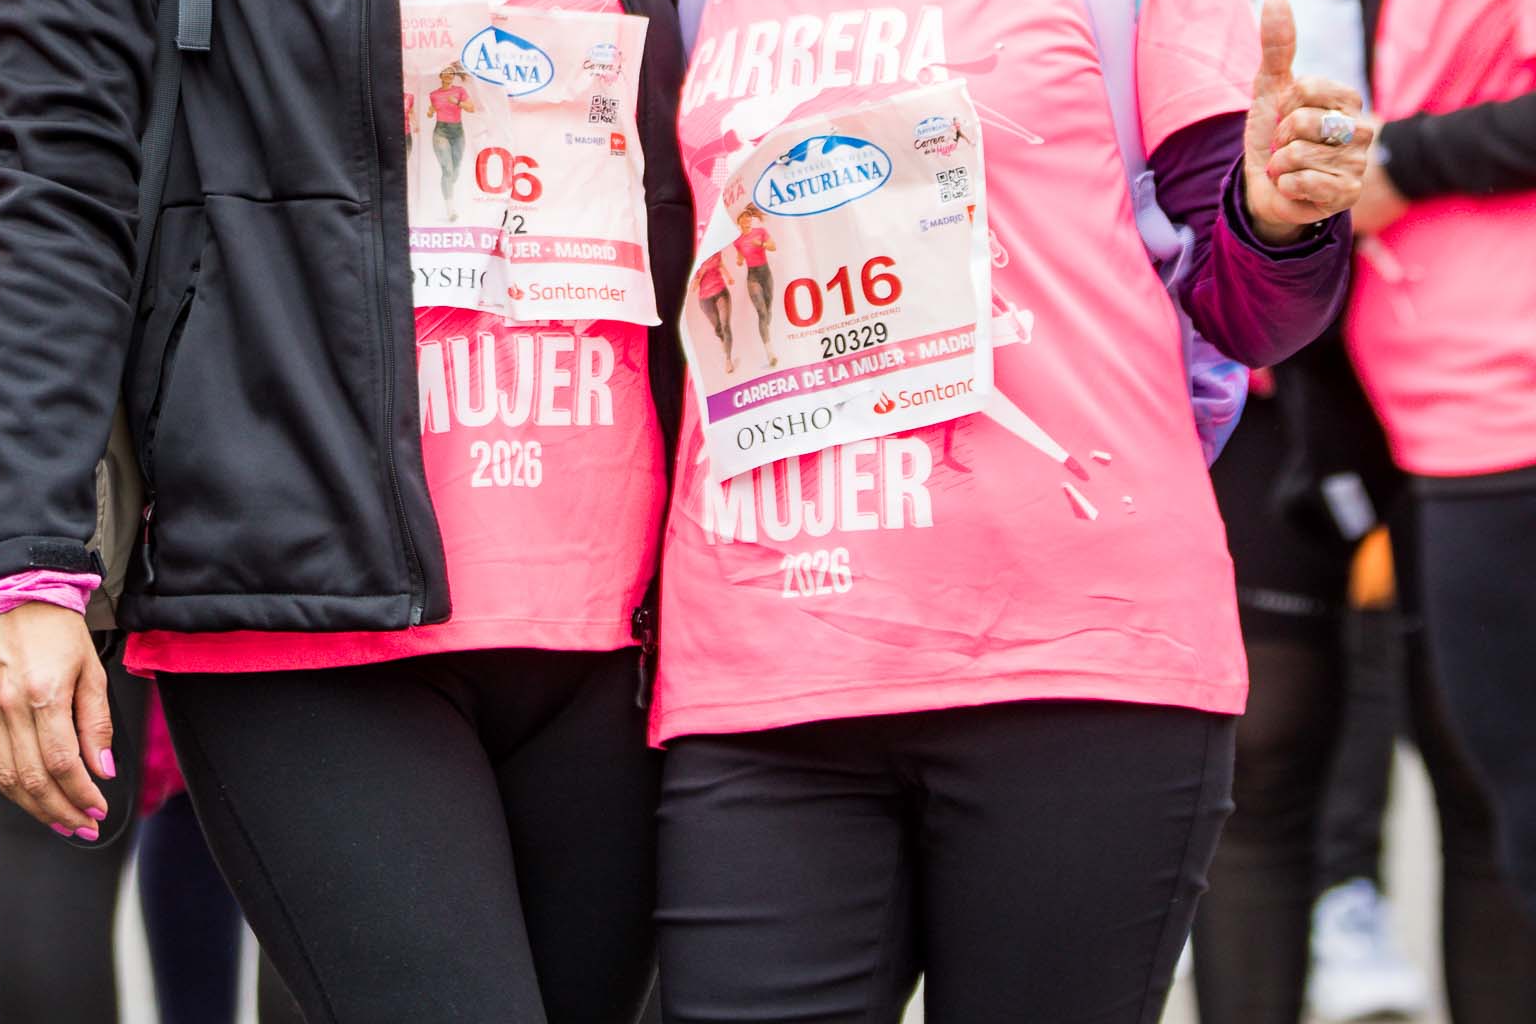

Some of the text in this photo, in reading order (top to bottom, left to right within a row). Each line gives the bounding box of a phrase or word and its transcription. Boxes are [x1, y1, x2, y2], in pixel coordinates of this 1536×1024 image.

[403, 31, 454, 49] UMA
[682, 5, 950, 116] CARRERA
[475, 146, 543, 203] 06
[768, 160, 884, 207] ASTURIANA
[410, 232, 476, 249] ARRERA
[930, 214, 964, 228] MADRID
[555, 243, 617, 260] MADRID
[414, 267, 487, 289] YSH
[529, 283, 627, 302] Santander
[784, 256, 903, 327] 016
[820, 322, 888, 359] 20329
[417, 332, 614, 435] MUJER
[733, 330, 976, 409] CARRERA DE LA MUJER MADRI
[737, 406, 833, 451] OYSHO
[470, 439, 543, 488] 2026
[704, 437, 934, 545] MUJER
[780, 547, 854, 599] 2026
